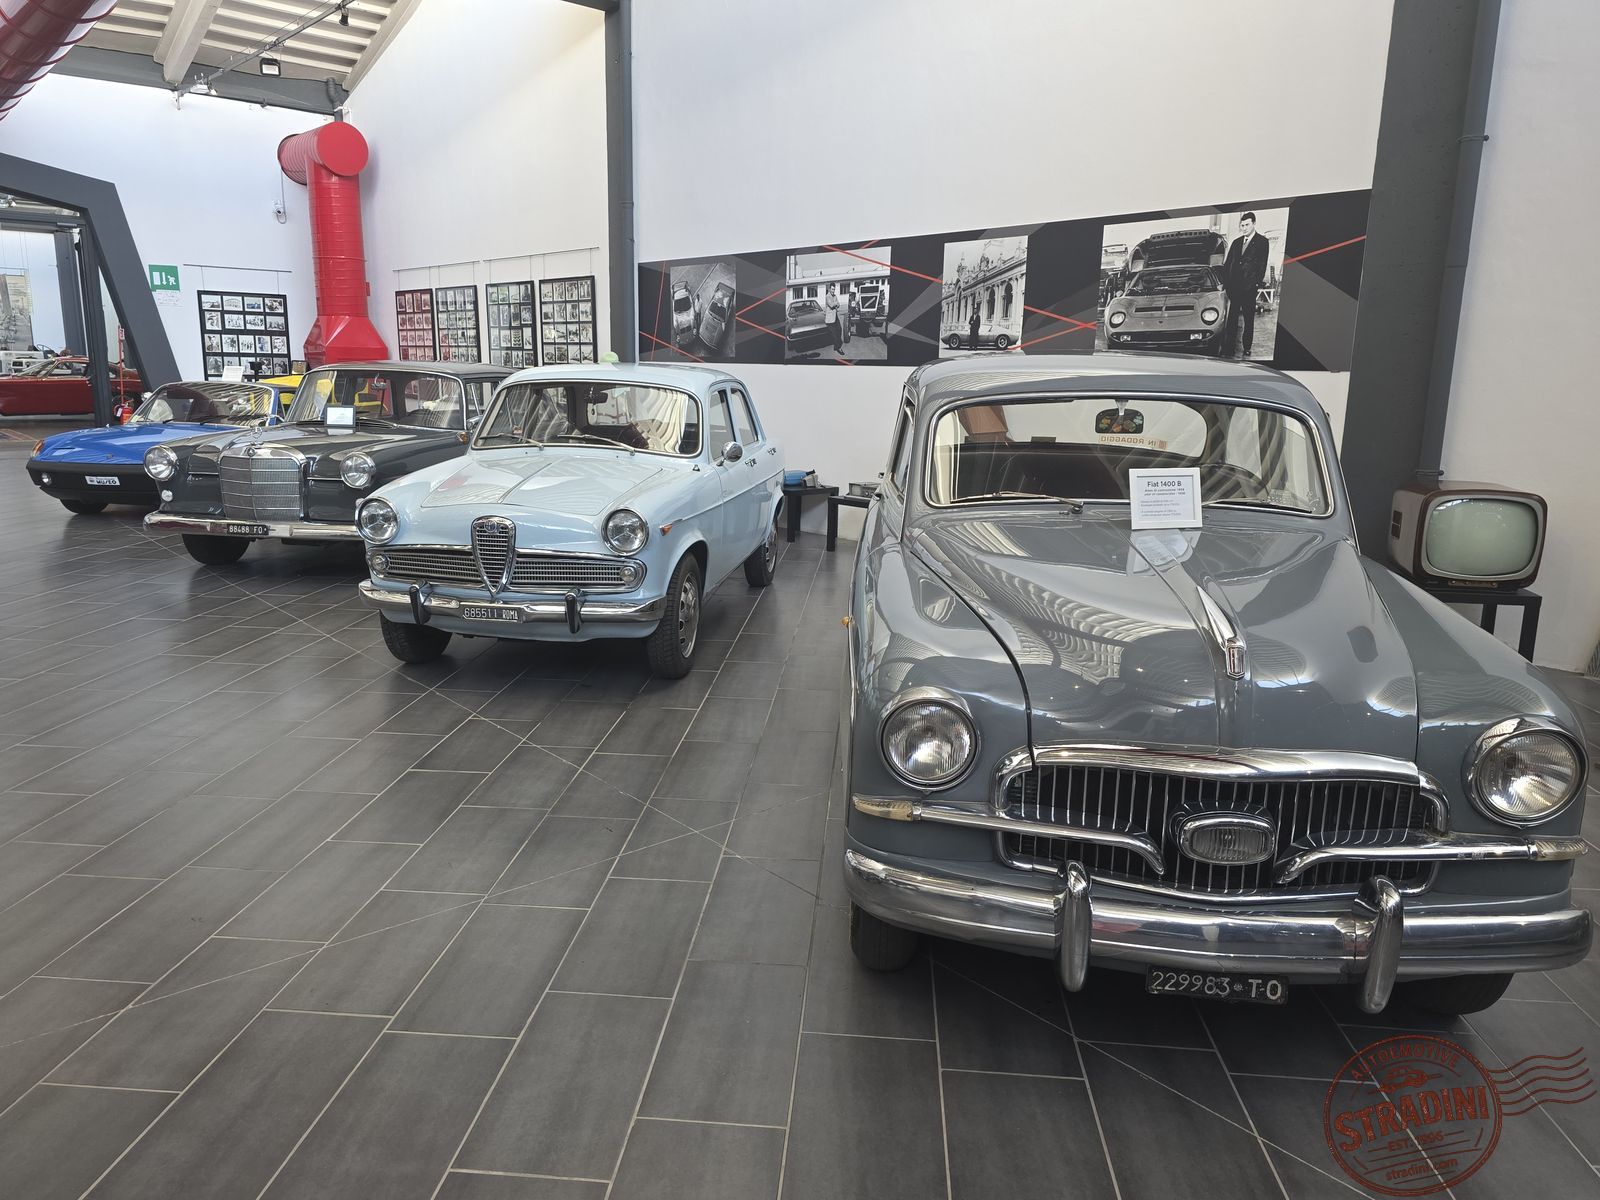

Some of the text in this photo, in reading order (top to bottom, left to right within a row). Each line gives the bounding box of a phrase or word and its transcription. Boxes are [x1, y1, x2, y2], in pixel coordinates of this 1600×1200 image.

[464, 607, 519, 620] 685511 ROMA
[1152, 971, 1231, 995] 229983
